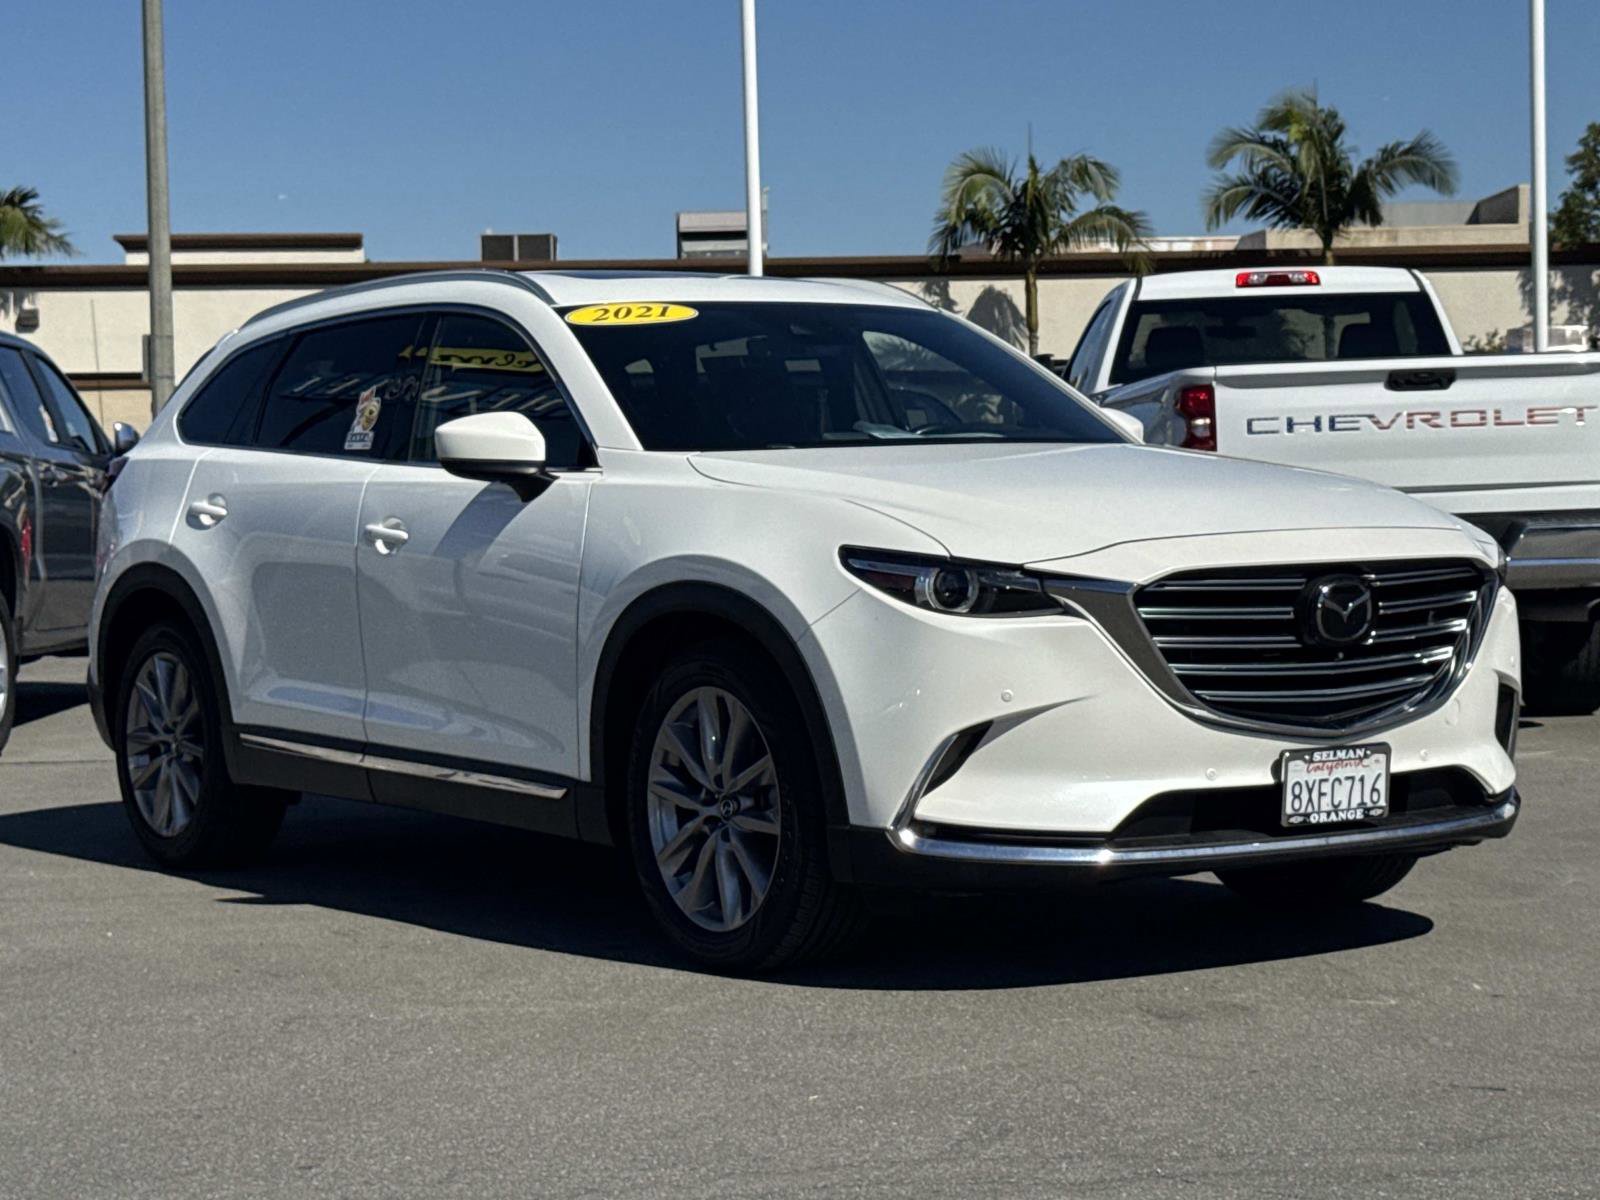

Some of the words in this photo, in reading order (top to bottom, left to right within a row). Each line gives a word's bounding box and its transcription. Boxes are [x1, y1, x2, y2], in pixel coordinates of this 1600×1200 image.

[592, 305, 670, 322] 2021
[1246, 406, 1598, 435] CHEVROLET
[1313, 748, 1364, 761] SELMAN
[1291, 773, 1382, 813] 8XFC716
[1309, 809, 1364, 824] ORANGE
